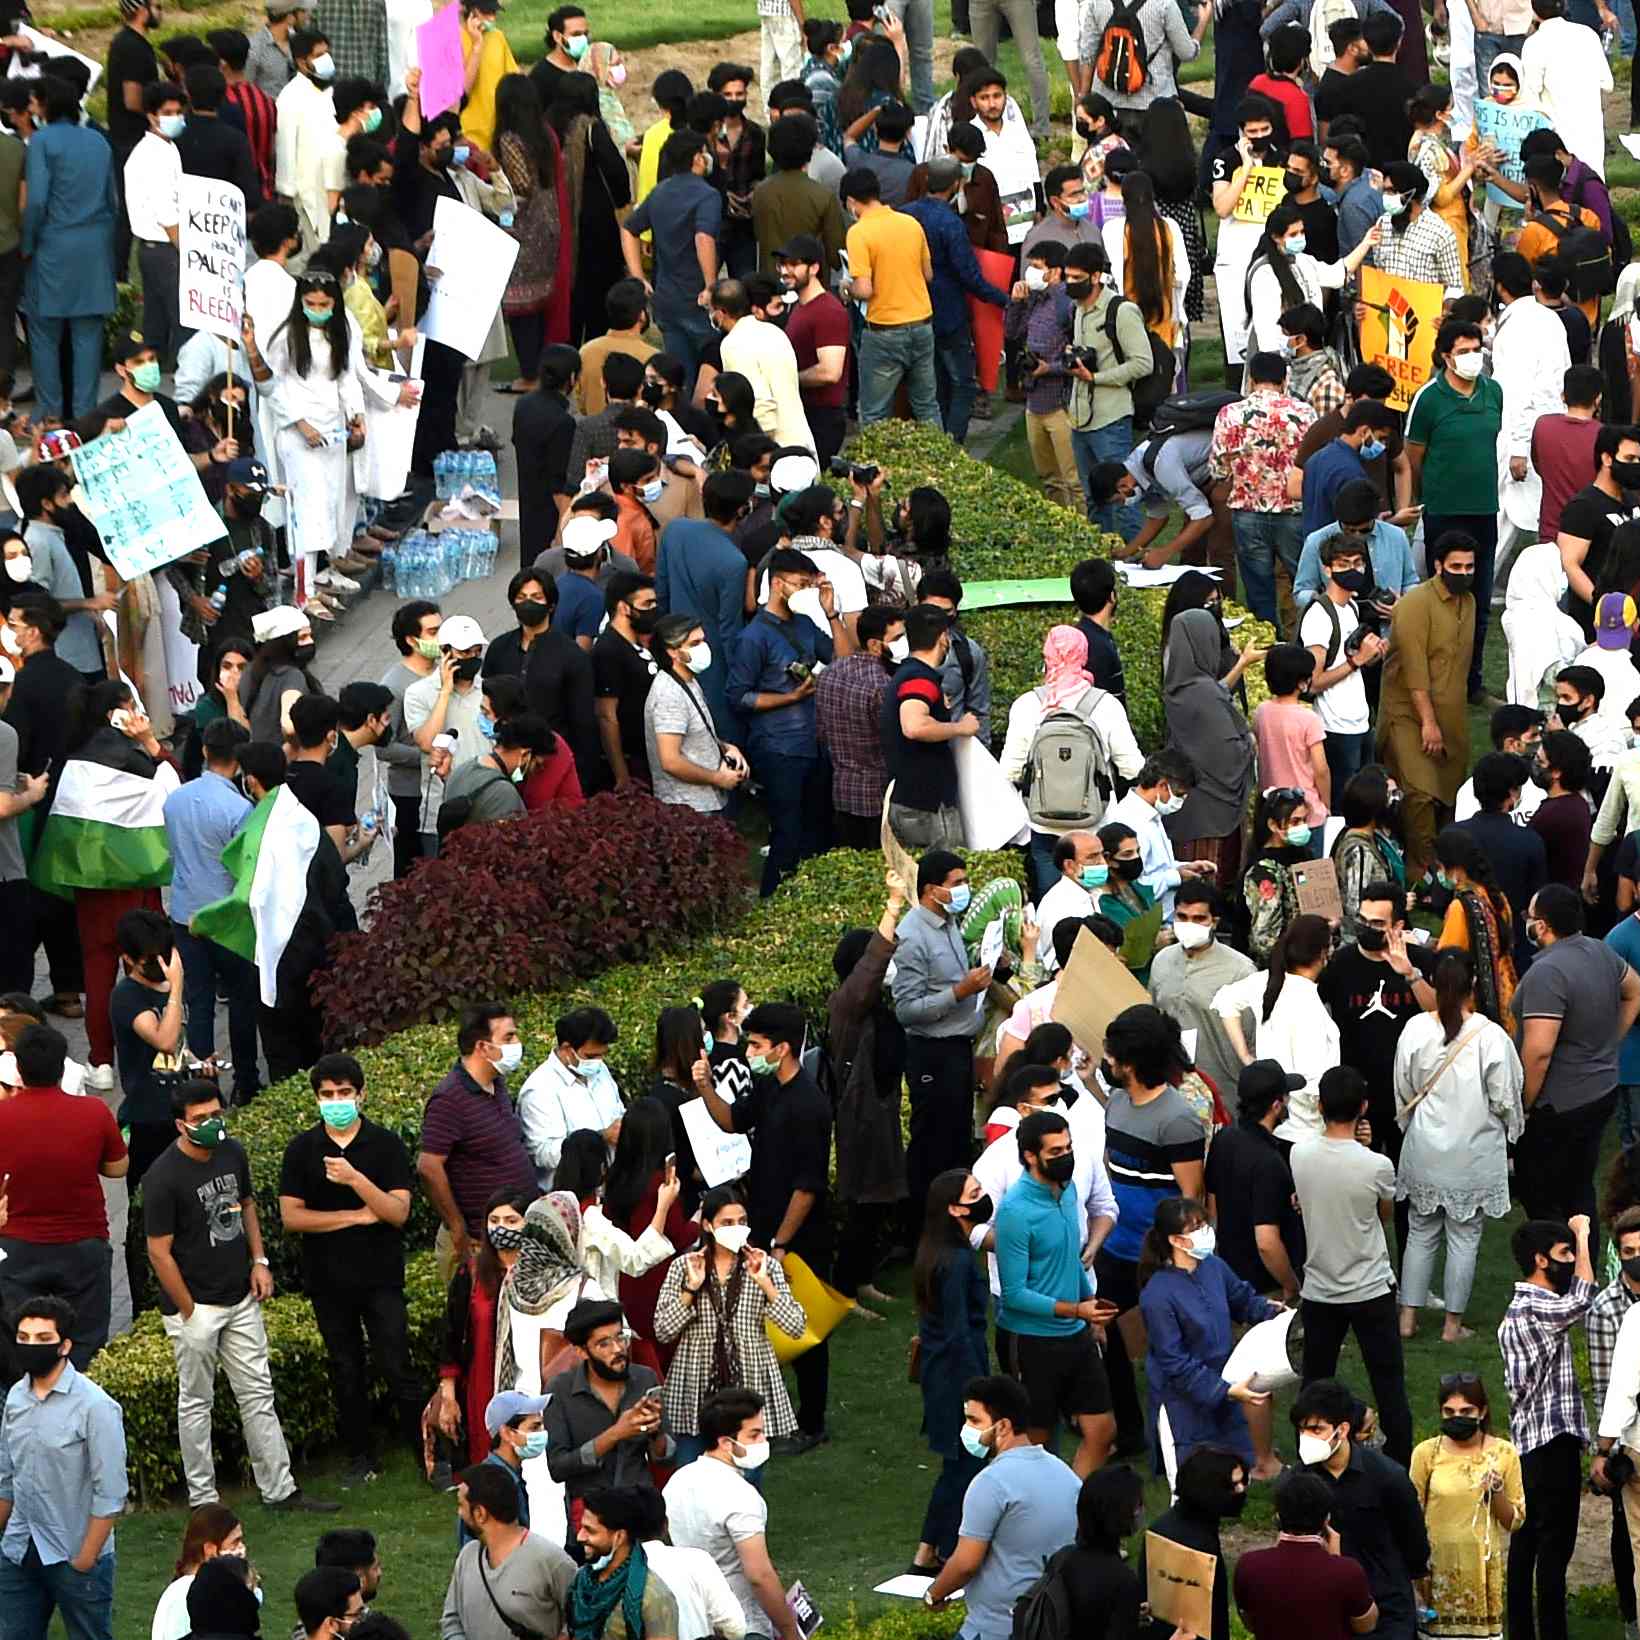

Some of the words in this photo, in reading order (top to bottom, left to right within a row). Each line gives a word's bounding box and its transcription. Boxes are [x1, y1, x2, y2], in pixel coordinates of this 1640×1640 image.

[1243, 176, 1279, 197] FRE
[189, 210, 231, 236] KEEP
[188, 248, 241, 283] PALES
